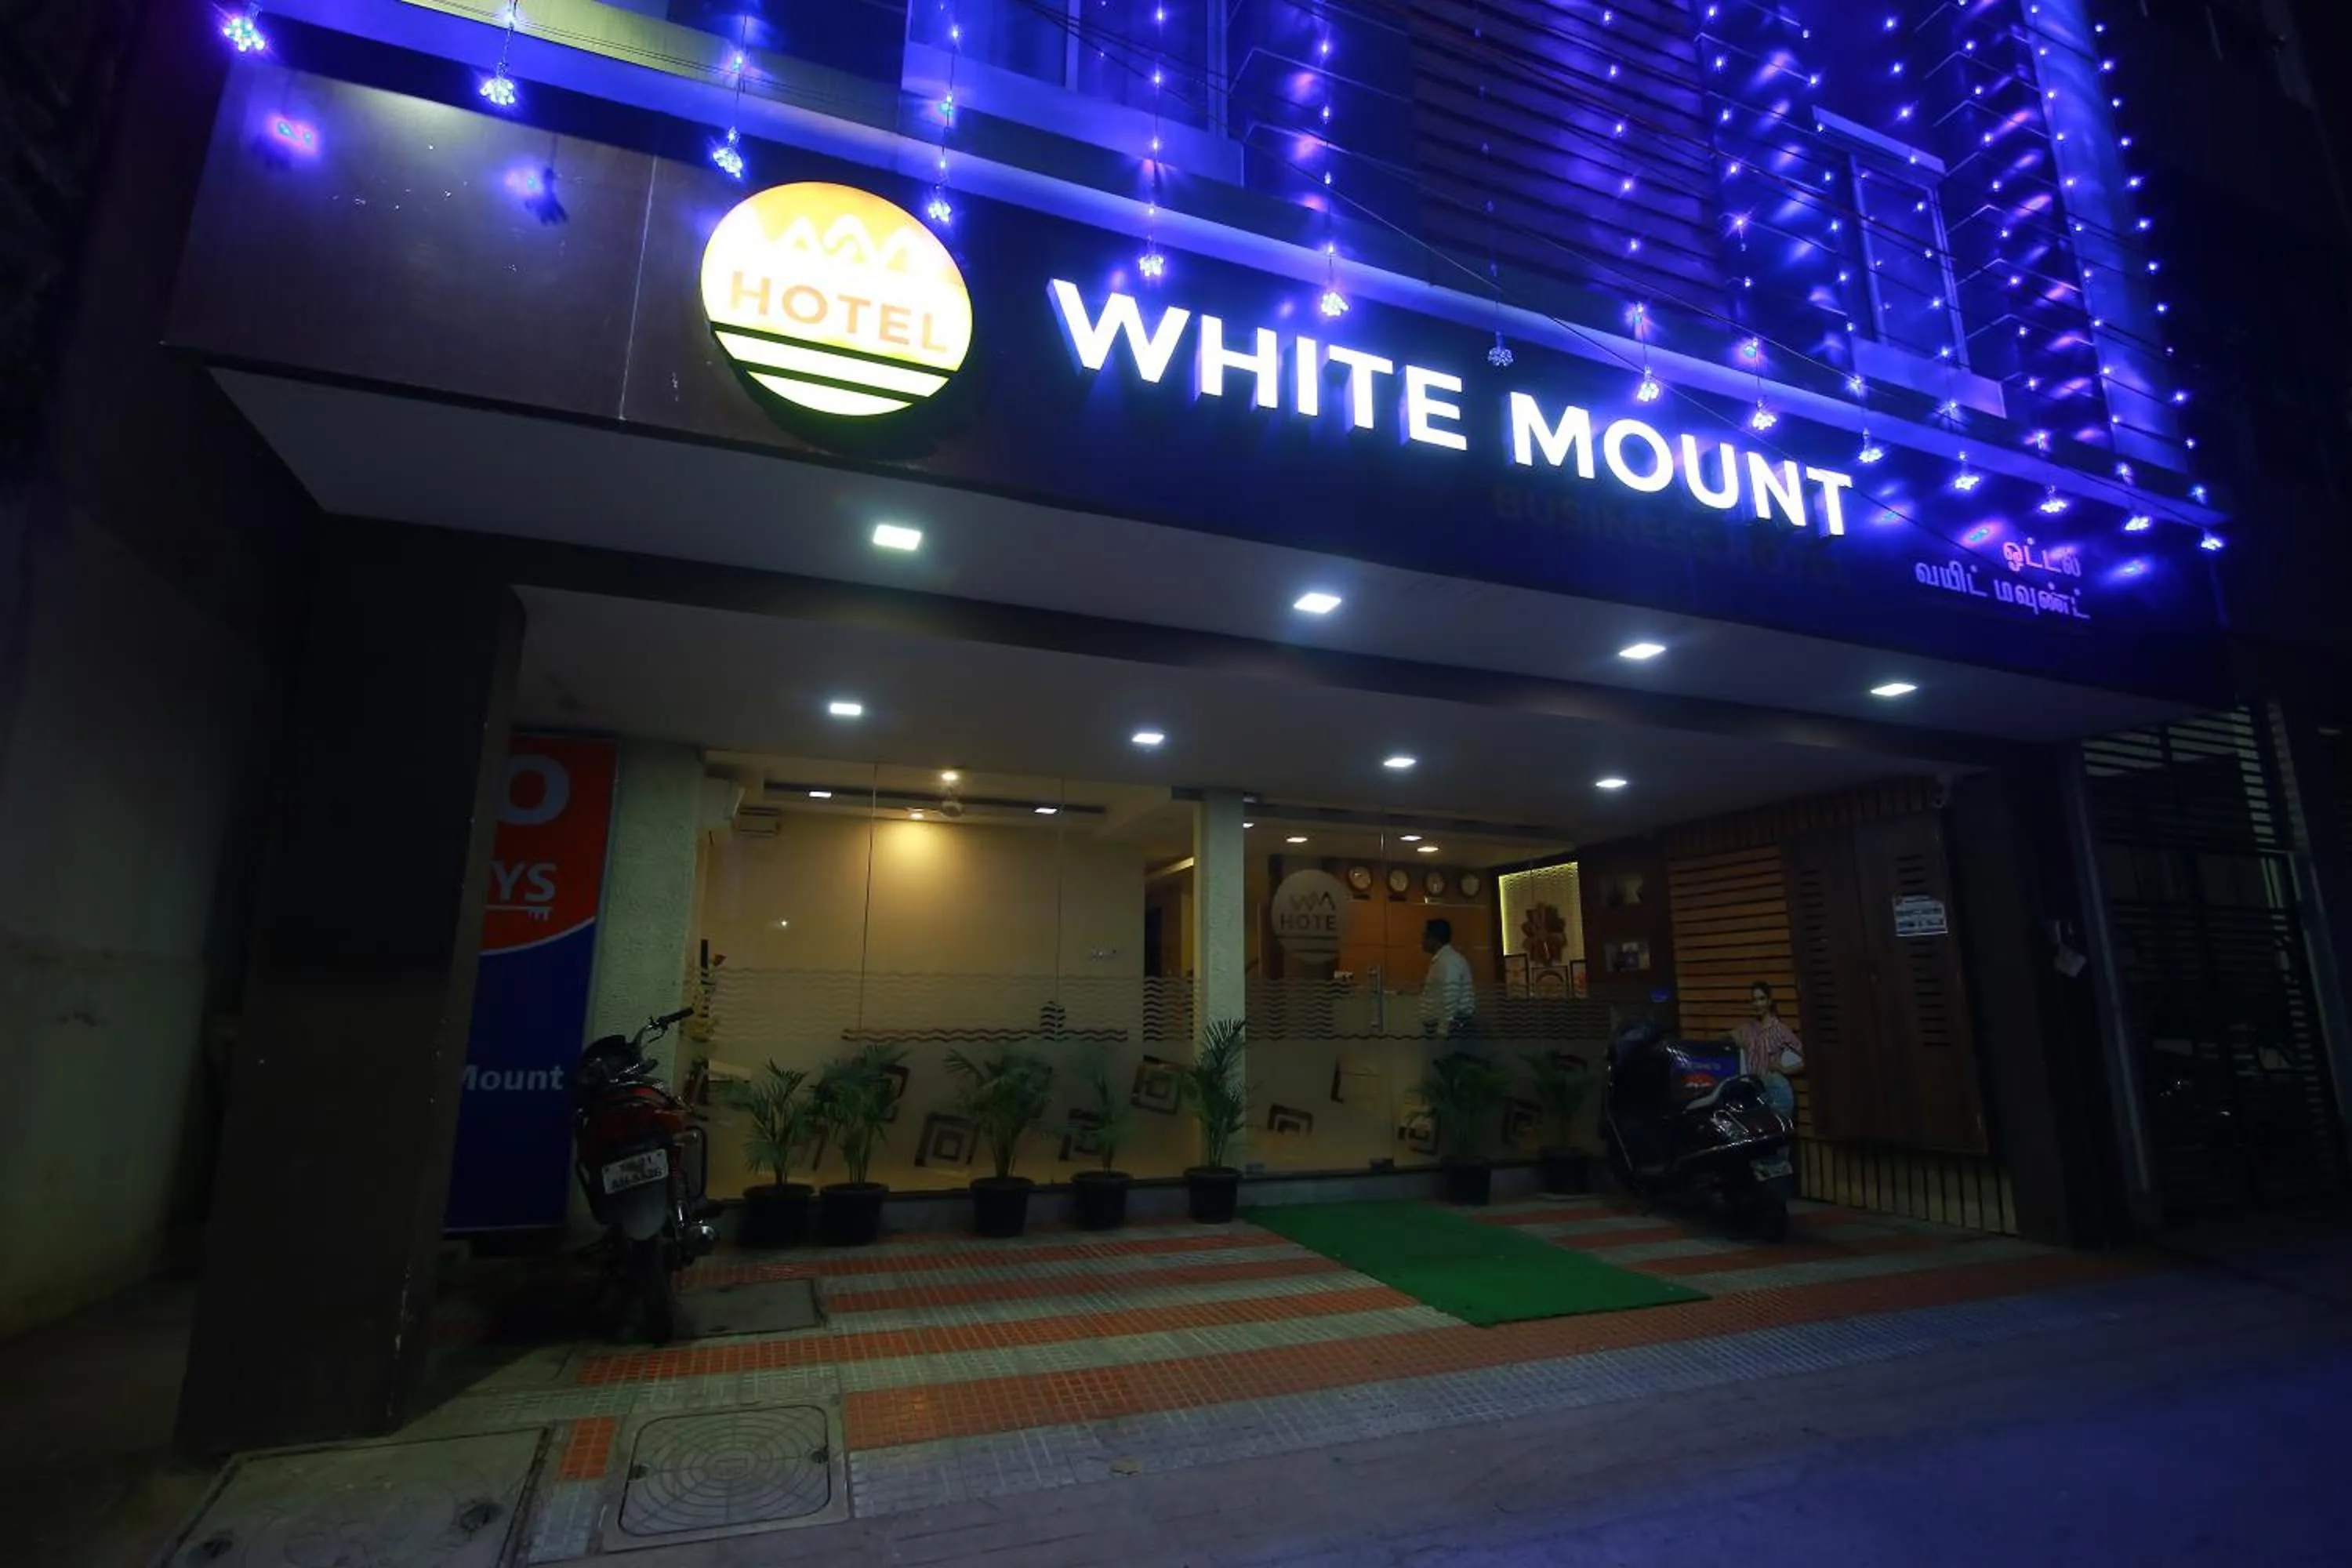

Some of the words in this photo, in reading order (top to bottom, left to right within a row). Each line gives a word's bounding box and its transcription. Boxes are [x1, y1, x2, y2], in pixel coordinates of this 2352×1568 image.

[728, 270, 947, 353] HOTEL
[1049, 278, 1467, 451] WHITE
[1510, 392, 1852, 537] MOUNT
[1493, 483, 1714, 558] BUSINESS
[1280, 913, 1339, 932] HOTE
